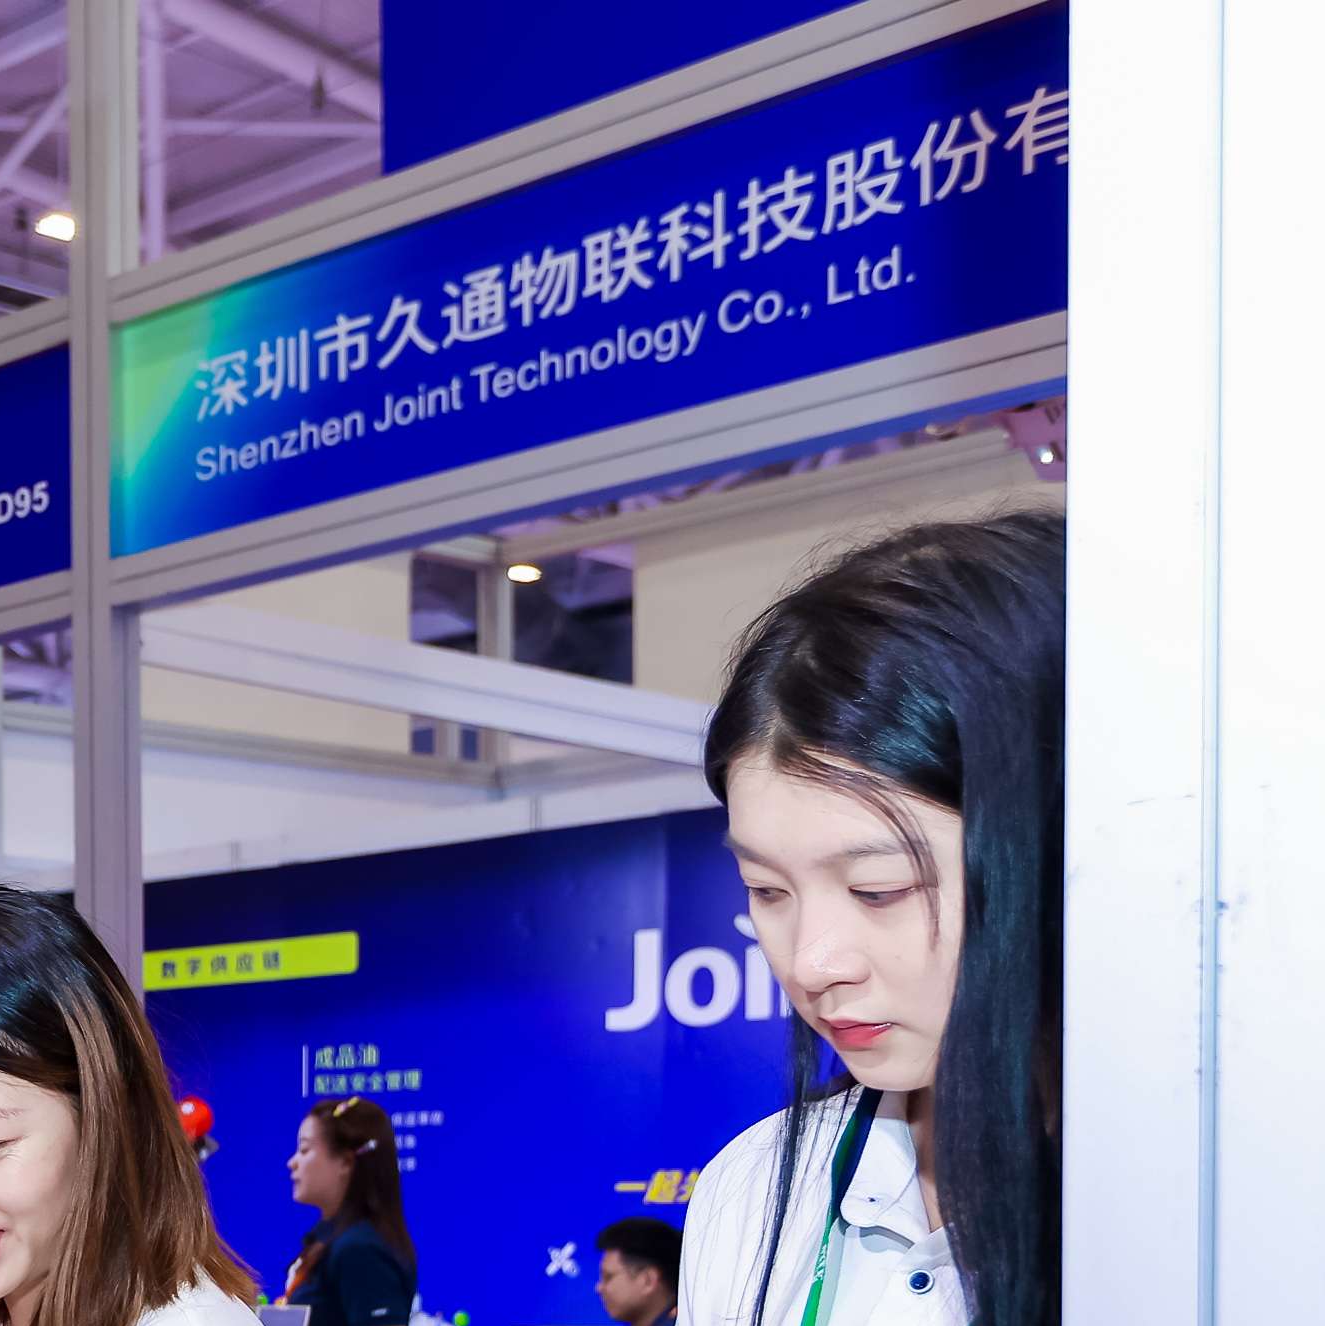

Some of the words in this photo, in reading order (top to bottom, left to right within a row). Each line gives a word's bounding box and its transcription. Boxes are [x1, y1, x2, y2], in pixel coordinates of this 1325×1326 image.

[194, 86, 1068, 422] 深圳市久通物联科技股份有
[194, 415, 366, 482] Shenzhen
[373, 374, 463, 430] Joint
[469, 310, 705, 406] Technology
[717, 287, 811, 335] Co.,
[825, 245, 916, 307] Ltd.
